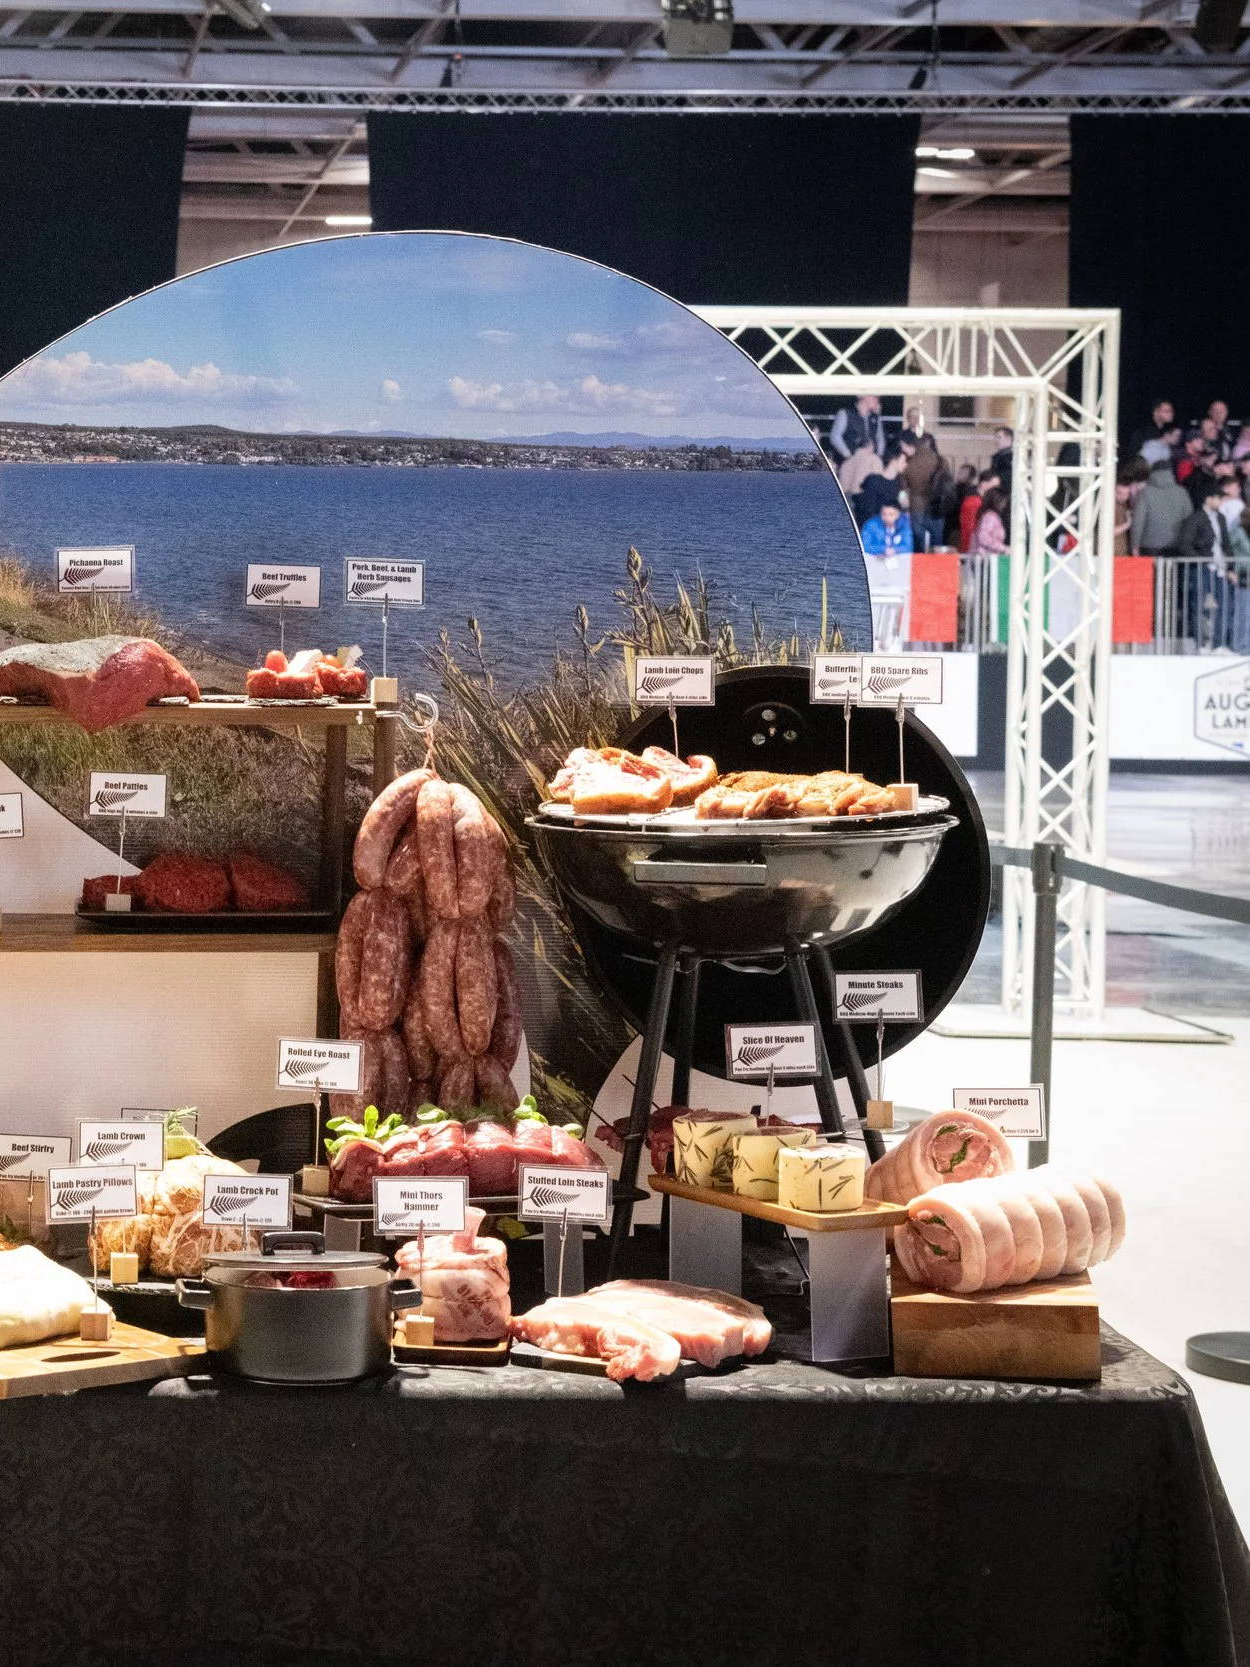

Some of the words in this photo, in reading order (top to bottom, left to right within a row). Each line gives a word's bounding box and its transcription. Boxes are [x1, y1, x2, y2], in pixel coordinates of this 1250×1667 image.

[279, 573, 307, 581] Truffles
[357, 573, 374, 581] Herb
[376, 574, 411, 582] Sausages
[644, 666, 664, 674] Lamb
[665, 666, 680, 674] Loin
[825, 665, 858, 673] Butterfli
[888, 667, 910, 675] Spare
[911, 667, 928, 675] Ribs
[1212, 714, 1250, 729] LAM
[104, 781, 121, 789] Beef
[122, 782, 148, 790] Patties
[848, 981, 875, 989] Minute
[876, 981, 904, 989] Steaks
[743, 1036, 763, 1045] Slice
[764, 1036, 773, 1044] Of
[774, 1035, 805, 1044] Heaven
[288, 1047, 312, 1057] Rolled
[313, 1049, 327, 1058] Eye
[328, 1051, 350, 1059] Roast
[969, 1098, 987, 1106] Mini
[988, 1097, 1029, 1106] Porchetta
[97, 1132, 119, 1140] Lamb
[120, 1132, 146, 1140] Crown
[11, 1143, 29, 1152] Beef
[30, 1144, 55, 1154] Stirfry
[52, 1180, 74, 1189] Lamb
[76, 1179, 102, 1188] Pastry
[103, 1178, 133, 1187] Pillows
[528, 1175, 557, 1185] Stuffed
[558, 1177, 575, 1187] Loin
[576, 1179, 604, 1188] Steaks
[217, 1186, 239, 1194] Lamb
[240, 1186, 264, 1195] Crock
[265, 1187, 279, 1196] Pot
[400, 1191, 418, 1199] Mini
[419, 1191, 443, 1200] Thors
[404, 1202, 439, 1211] Hammer
